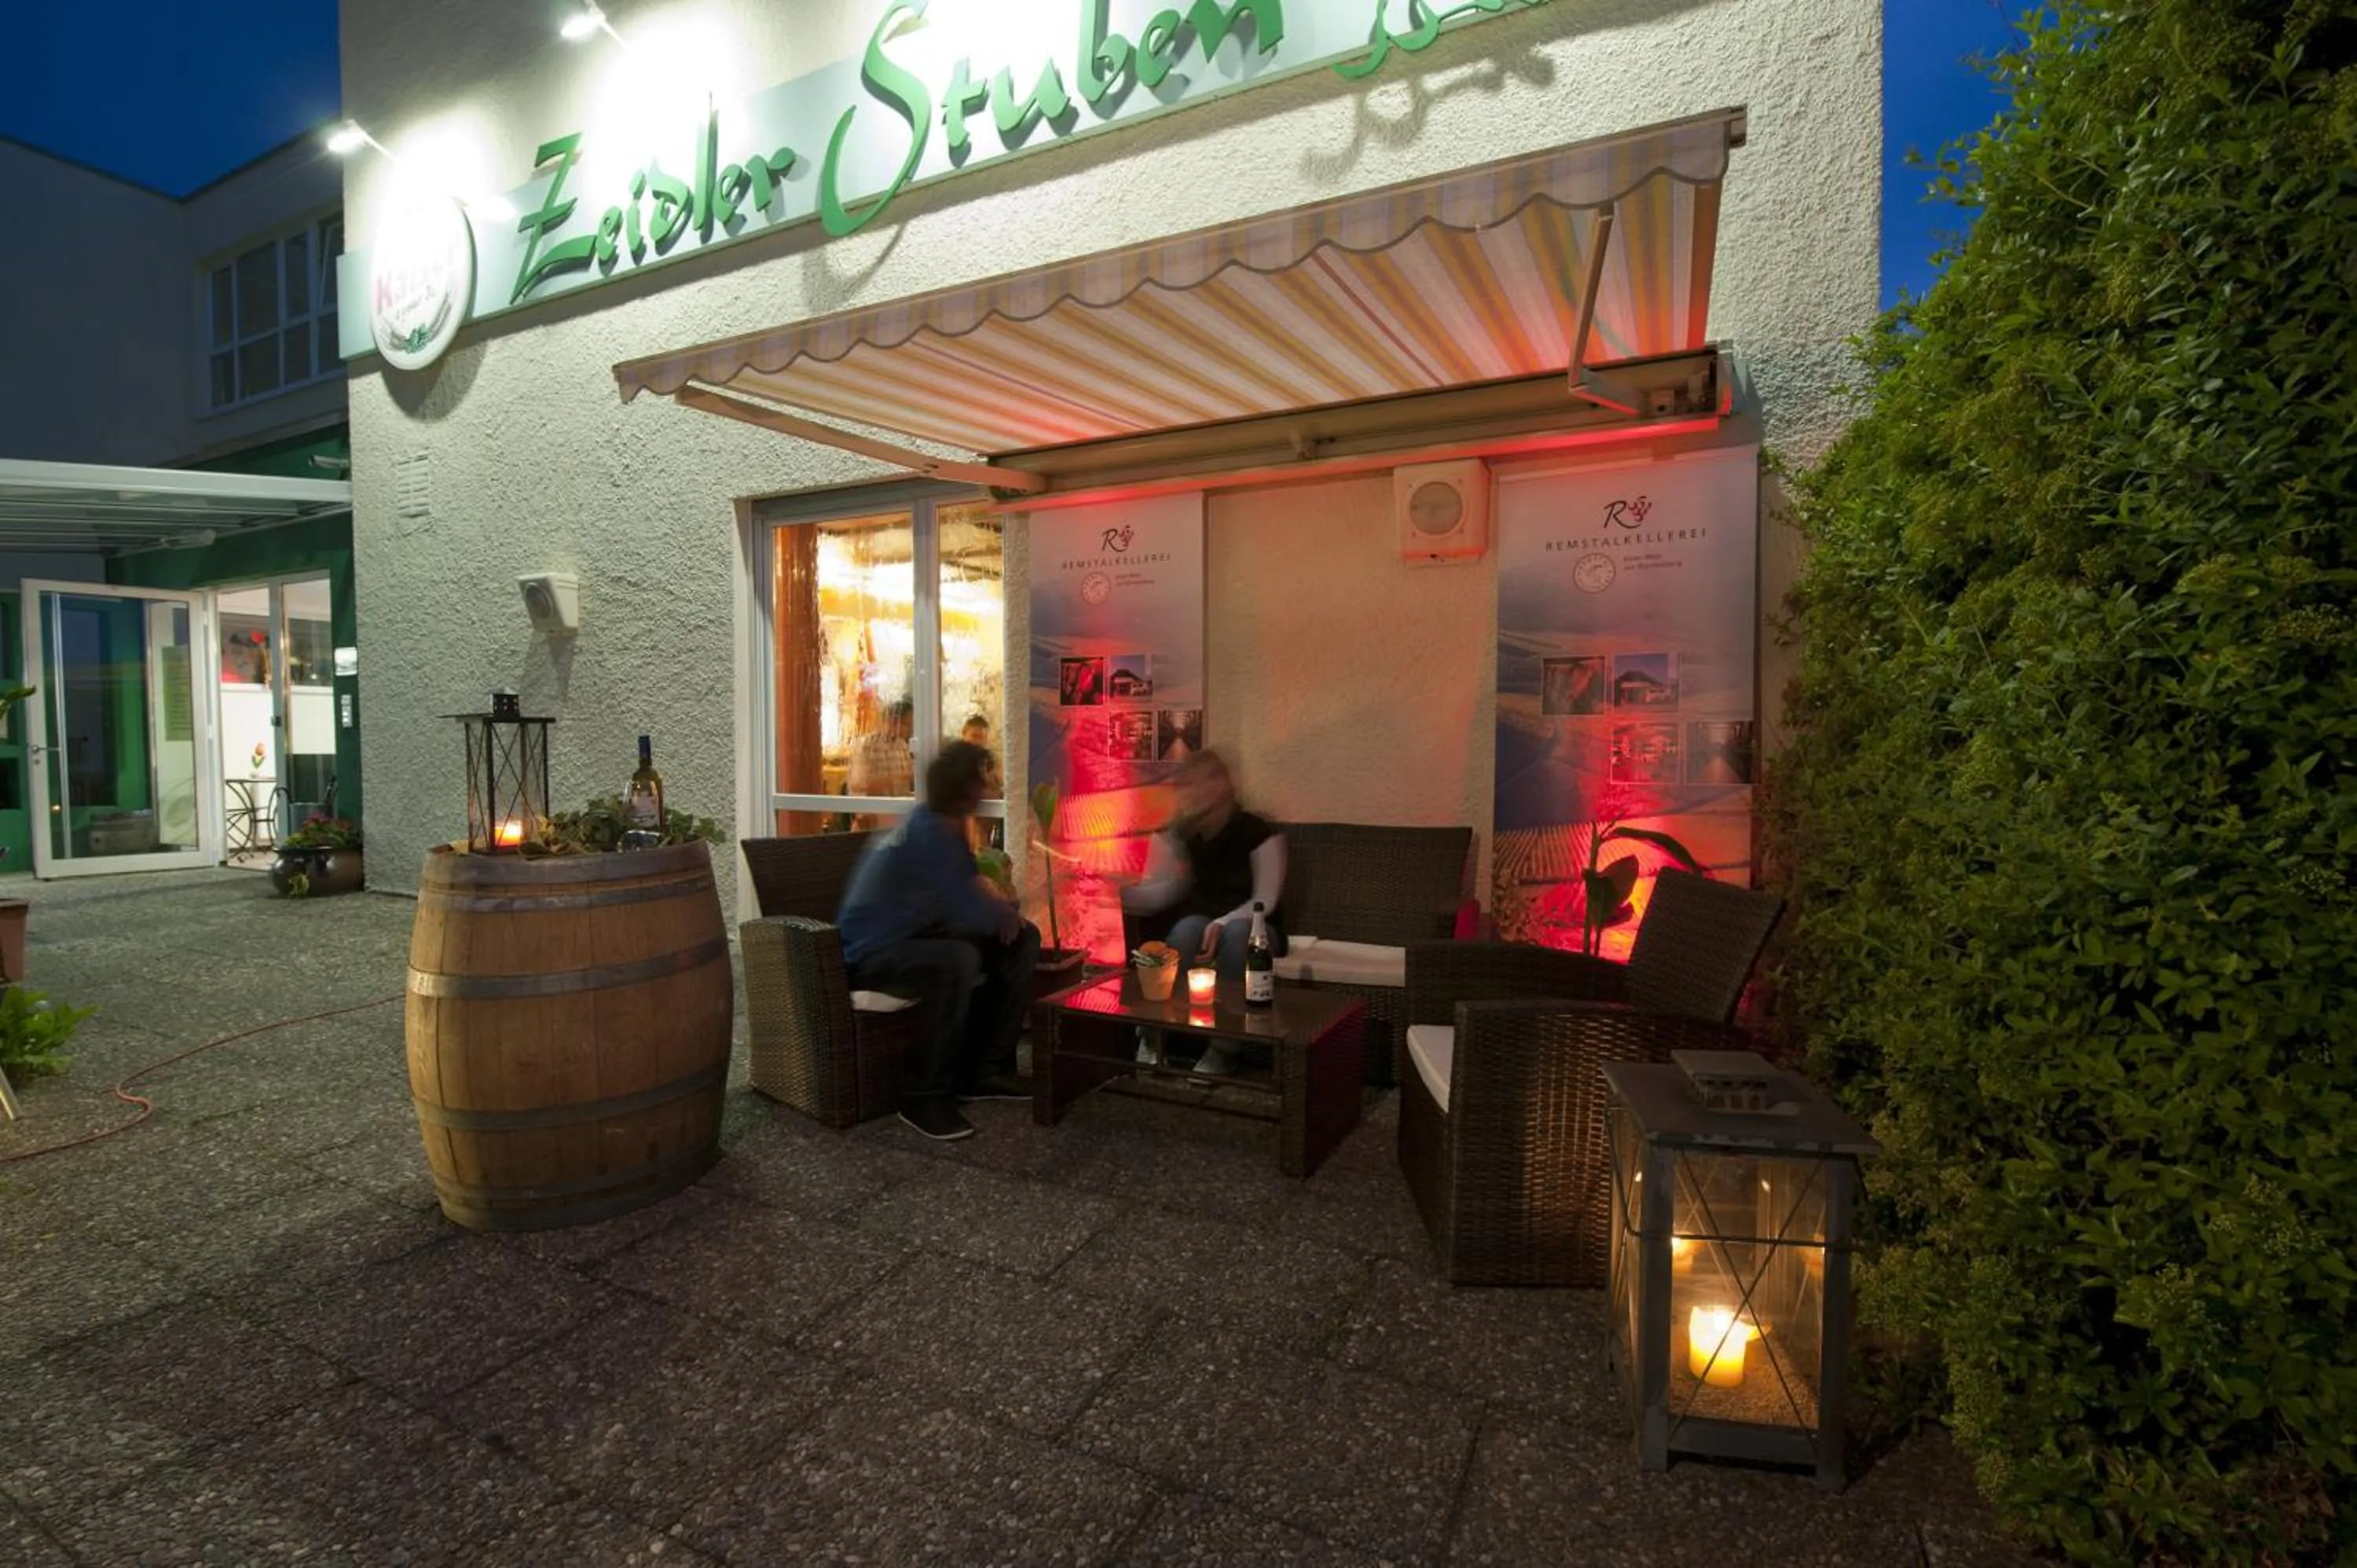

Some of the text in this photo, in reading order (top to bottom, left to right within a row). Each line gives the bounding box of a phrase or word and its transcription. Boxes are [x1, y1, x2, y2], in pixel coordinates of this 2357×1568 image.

[510, 0, 1285, 305] Zeidler Stuben
[1545, 527, 1707, 551] REMSTALKELLEREI
[1061, 552, 1171, 570] REMSTALKELLEREI
